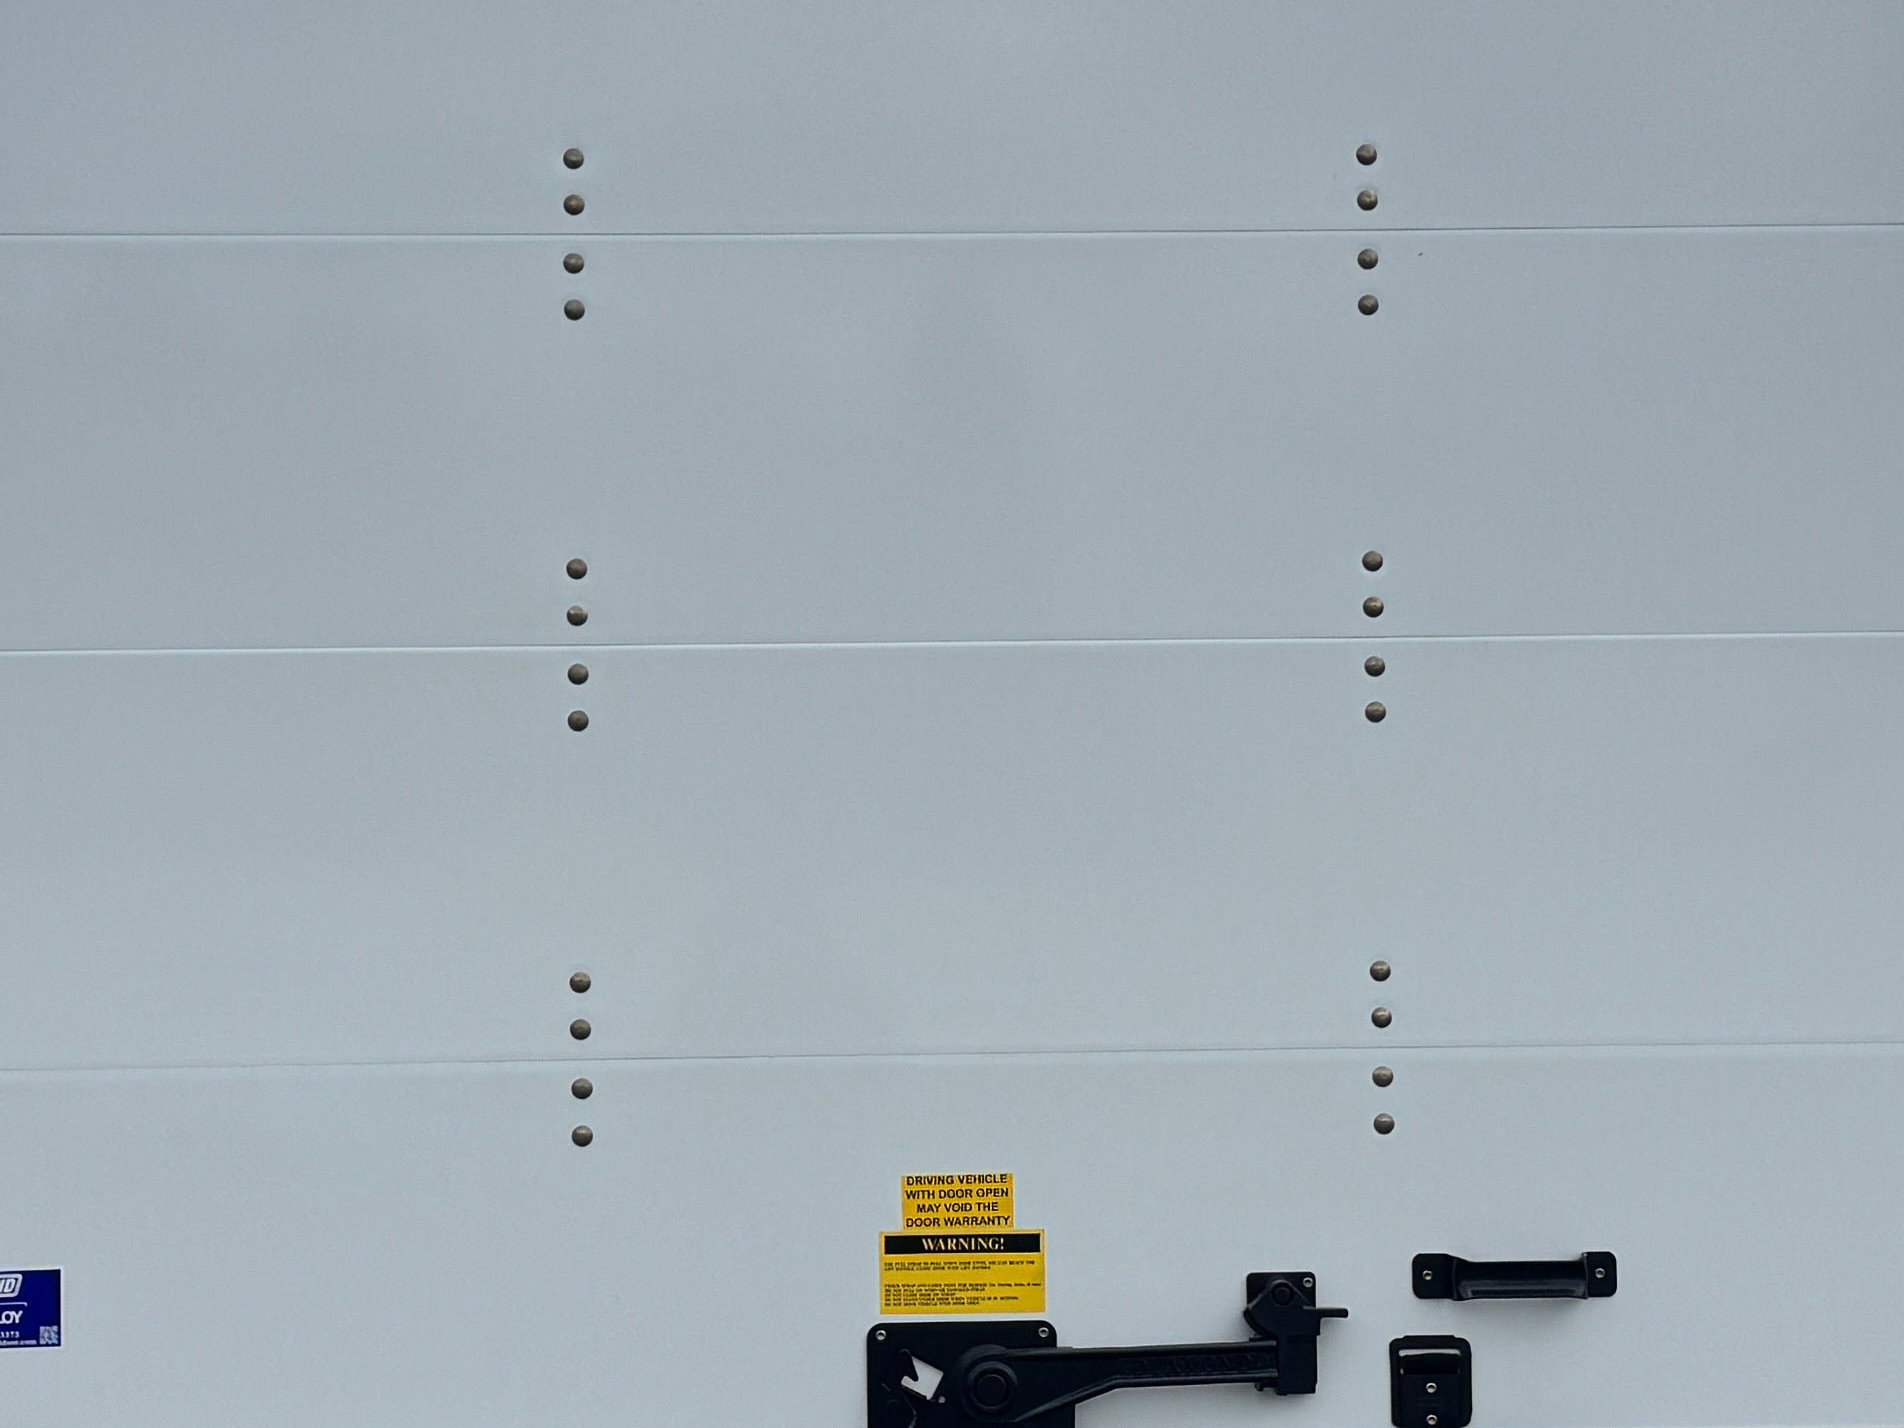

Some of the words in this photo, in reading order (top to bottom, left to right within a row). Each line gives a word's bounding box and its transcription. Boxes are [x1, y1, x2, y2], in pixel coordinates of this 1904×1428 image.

[906, 1175, 955, 1186] DRIVING
[957, 1174, 1008, 1185] VEHICLE
[905, 1189, 936, 1200] WITH
[938, 1188, 973, 1199] DOOR
[976, 1187, 1009, 1198] OPEN
[916, 1203, 941, 1214] MAY
[943, 1202, 973, 1213] VOID
[975, 1201, 999, 1212] THE
[905, 1217, 941, 1228] DOOR
[943, 1215, 1011, 1227] WARRANTY
[921, 1237, 1005, 1252] WARNING!
